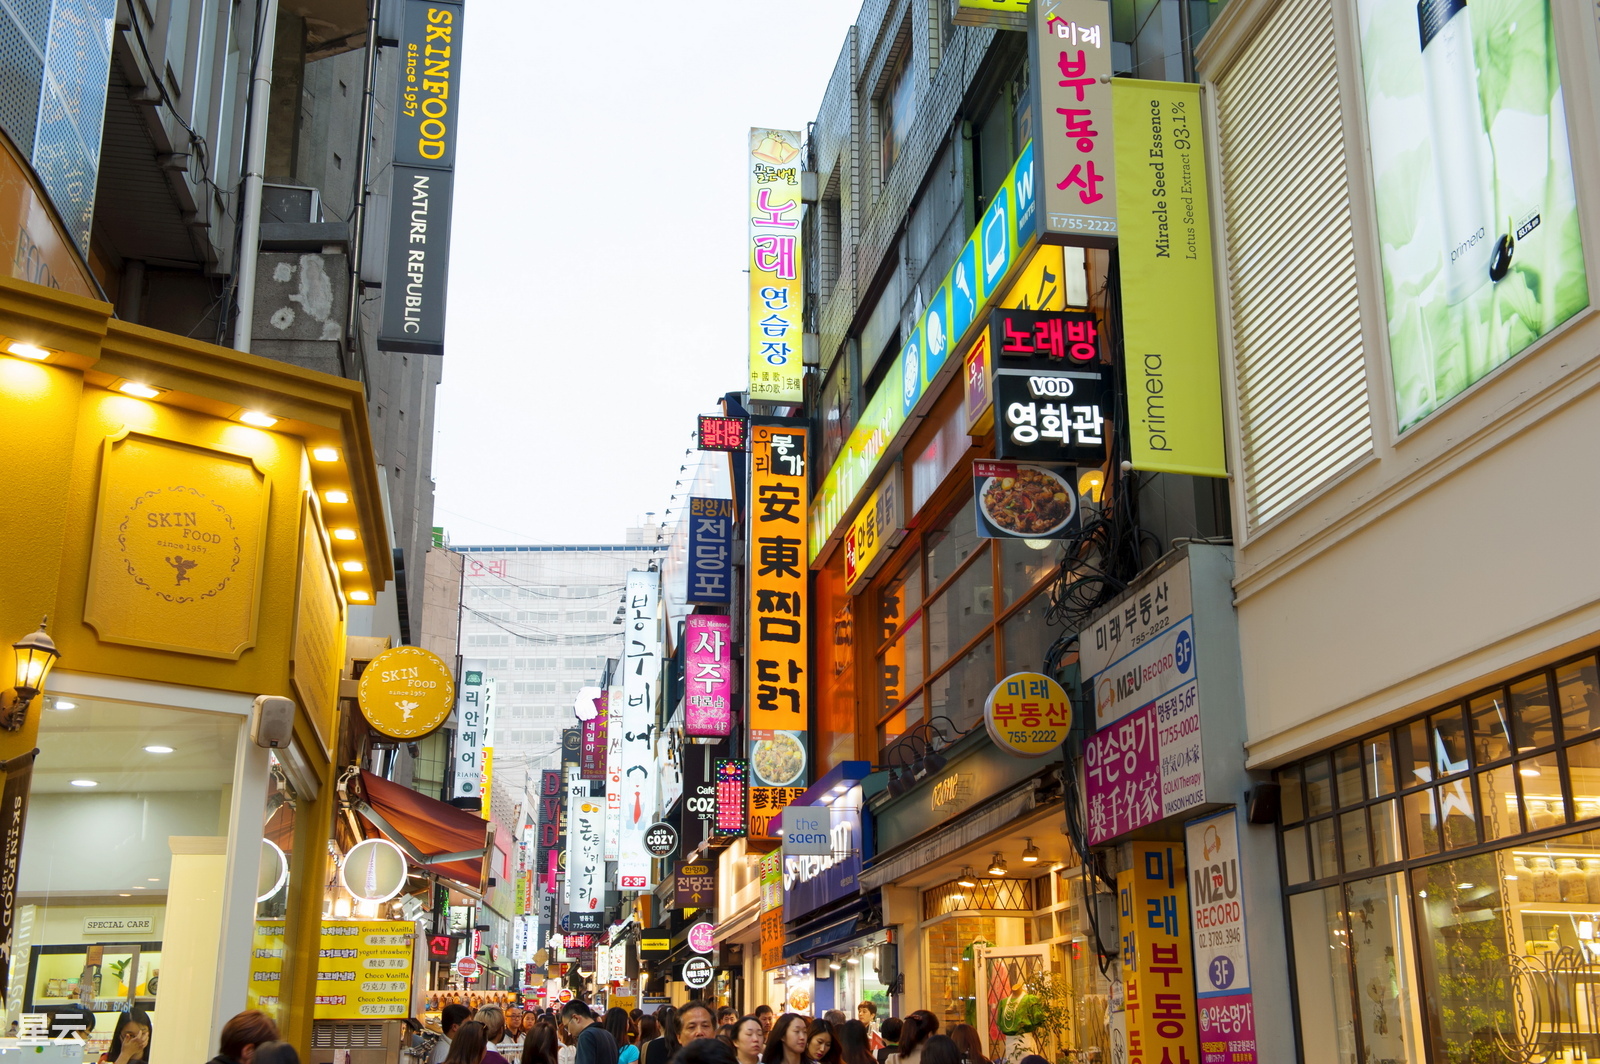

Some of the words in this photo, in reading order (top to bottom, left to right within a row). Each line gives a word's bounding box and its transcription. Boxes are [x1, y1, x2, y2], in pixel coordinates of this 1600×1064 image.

[1057, 22, 1101, 48] 미래
[404, 42, 417, 78] since
[402, 80, 416, 118] 1957
[419, 8, 453, 160] SKINFOOD
[1056, 50, 1104, 205] 부동산
[1150, 100, 1164, 159] Essence
[1171, 101, 1191, 150] 93.1%
[753, 163, 798, 186] 골든벨
[1152, 163, 1166, 198] Seed
[1180, 153, 1193, 195] Extract
[409, 175, 429, 244] NATURE
[1051, 216, 1117, 232] T.755-2222
[1182, 198, 1194, 225] Seed
[752, 188, 799, 280] 노래
[1153, 203, 1170, 258] Miracle
[1185, 228, 1196, 260] Lotus
[1450, 226, 1486, 264] primera
[404, 249, 424, 334] REPUBLIC
[760, 287, 792, 366] 연습장
[1002, 317, 1098, 361] 노래방
[751, 383, 781, 394] 日本の歌
[969, 361, 986, 398] 우리
[1031, 378, 1074, 397] VOD
[1142, 354, 1172, 452] primera
[1007, 402, 1104, 445] 영화관
[754, 429, 771, 477] 우리
[771, 434, 805, 476] 봉가
[691, 498, 732, 518] 한양사
[813, 446, 854, 559] Multi
[147, 512, 197, 528] SKIN
[182, 528, 221, 544] FOOD
[858, 481, 895, 563] 안동찜닭
[156, 540, 184, 549] since
[186, 543, 207, 554] 1957
[693, 518, 728, 598] 전당포
[1130, 616, 1170, 647] 755-2222
[693, 630, 726, 694] 사주
[1142, 653, 1173, 683] RECORD
[1175, 638, 1190, 666] 3F
[381, 667, 419, 683] SKIN
[407, 679, 437, 689] FOOD
[626, 593, 657, 751] 봉구비어
[1007, 679, 1049, 699] 미래
[994, 702, 1068, 728] 부동산
[1157, 702, 1178, 724] 명동점
[1178, 686, 1196, 713] 5,6F
[461, 691, 480, 768] 리안헤어
[585, 722, 596, 763] 네일아트
[713, 721, 728, 731] 4F
[1007, 730, 1057, 744] 755-2222
[1159, 714, 1200, 748] T.755-0002
[1086, 709, 1155, 787] 약손명가
[1161, 743, 1200, 777] 骨気の本家
[1163, 775, 1180, 796] GOLKI
[1179, 771, 1202, 791] Therapy
[542, 772, 561, 847] DVD
[686, 797, 714, 812] COZ
[1164, 795, 1185, 815] YAKSON
[1184, 789, 1204, 809] HOUSE
[647, 835, 674, 846] COZY
[788, 832, 827, 844] saem
[795, 818, 819, 831] the
[3, 796, 21, 927] SKINFOOD
[0, 868, 8, 898] 1957
[677, 876, 714, 892] 전당포
[1145, 848, 1178, 937] 미래
[87, 921, 124, 929] SPECIAL
[127, 920, 150, 928] CARE
[1121, 882, 1137, 972] 미래
[1196, 901, 1240, 930] RECORD
[359, 949, 378, 957] yogurt
[380, 949, 411, 957] strawberry
[1214, 960, 1229, 986] 3F
[1210, 1003, 1252, 1034] 약손명가
